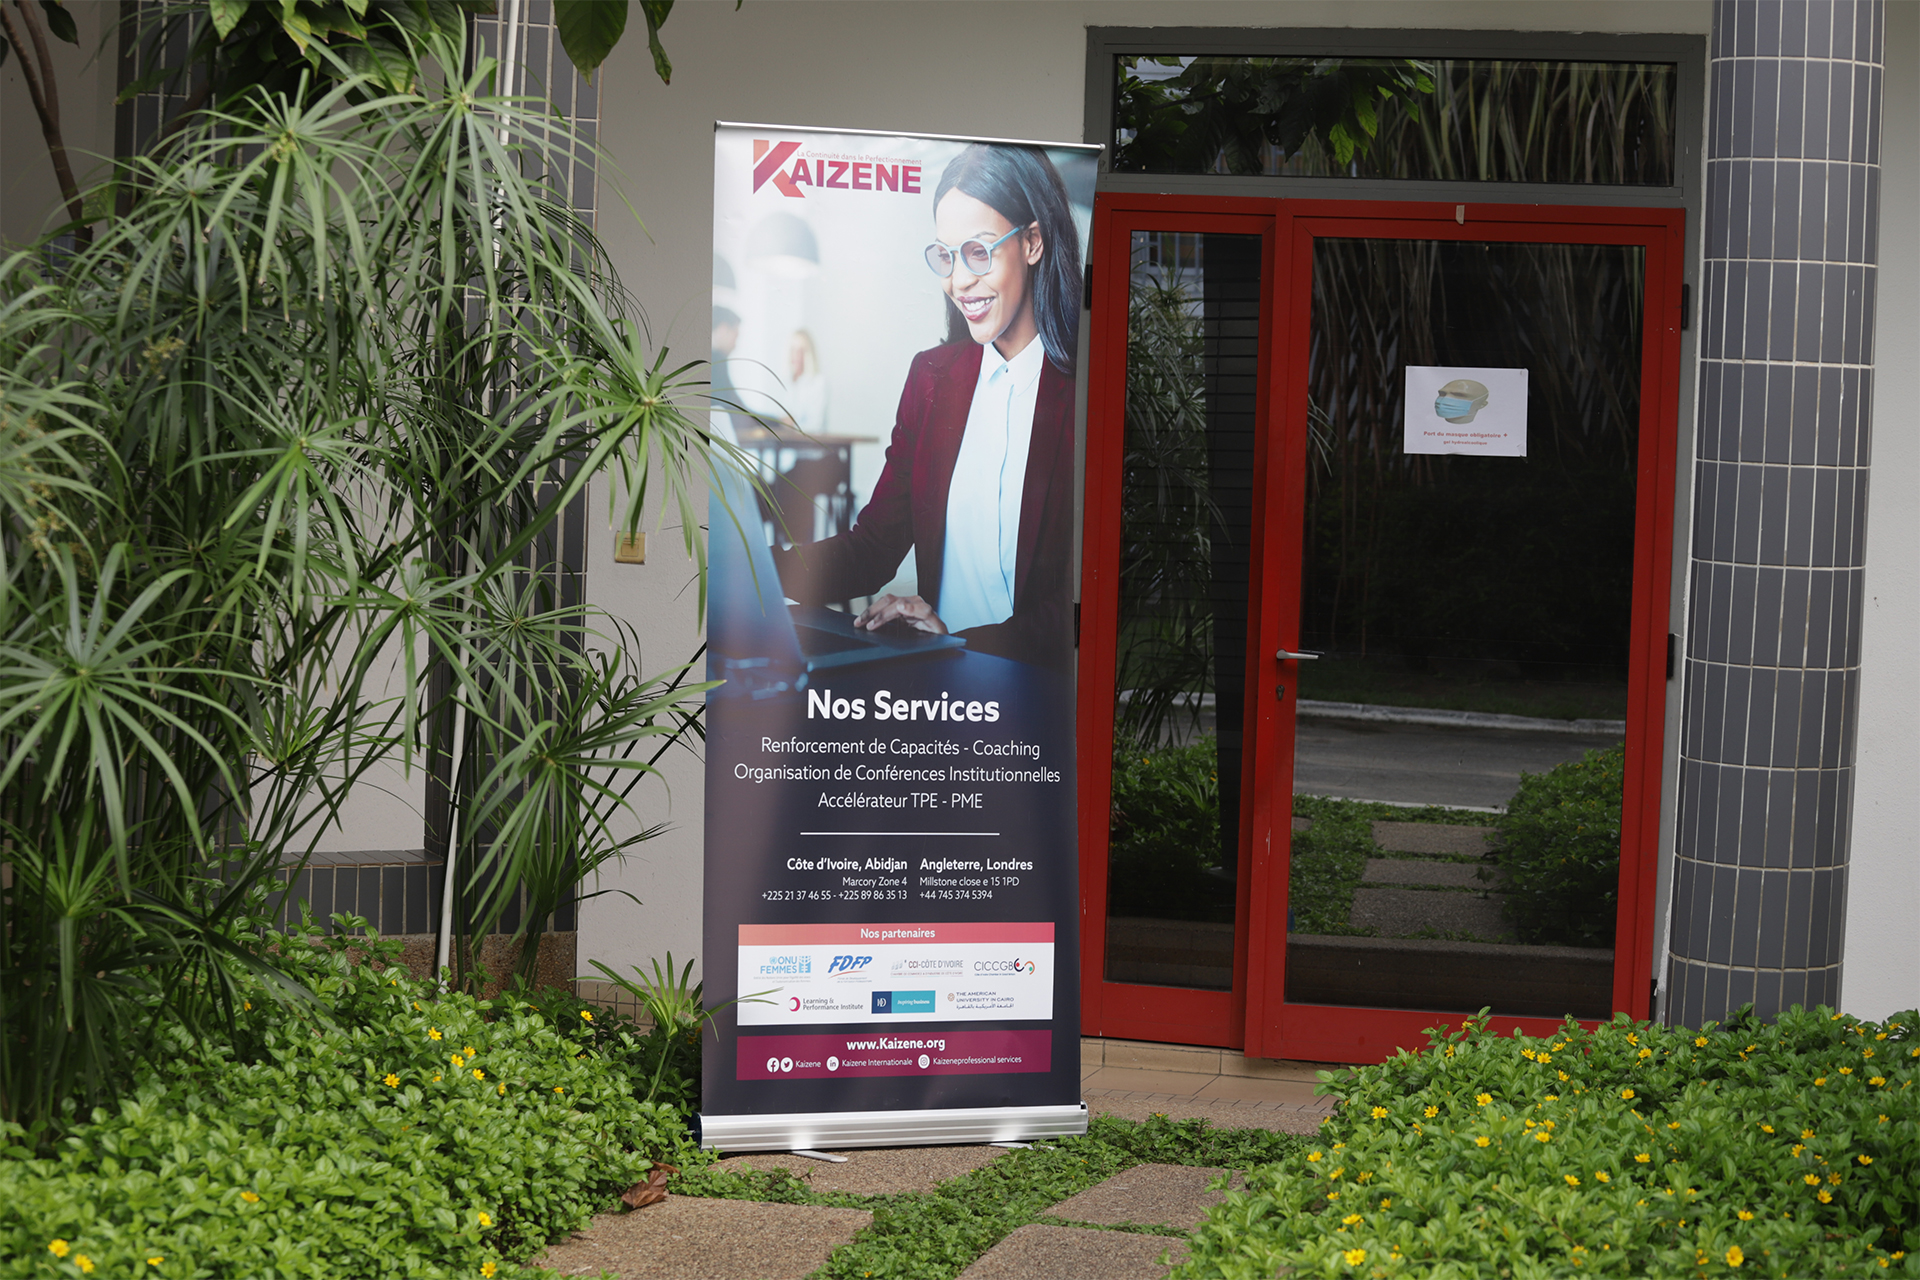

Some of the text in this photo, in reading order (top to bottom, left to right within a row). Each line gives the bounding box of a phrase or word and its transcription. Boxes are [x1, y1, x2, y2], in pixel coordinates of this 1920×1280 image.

[806, 150, 840, 160] Continuité
[865, 154, 922, 165] Perfectionnement
[807, 689, 1000, 722] Nos Services
[762, 737, 865, 754] Renforcement
[869, 738, 886, 754] de
[890, 738, 960, 758] Capacités
[973, 740, 1040, 760] Coaching
[734, 763, 1060, 783] Organisation de Conférences Institutionnelles
[818, 792, 907, 808] Accélérateur
[911, 793, 938, 808] TPE
[952, 793, 983, 808] PME
[787, 858, 814, 870] Côte
[865, 858, 908, 872] Abidjan
[920, 858, 1033, 872] Angleterre, Londres
[842, 877, 908, 888] Marcory Zone 4
[920, 876, 957, 886] Millstone
[959, 876, 980, 886] close
[990, 877, 1000, 886] 15
[1002, 877, 1020, 886] 1PD
[762, 890, 783, 900] +225
[785, 890, 794, 900] 21
[796, 890, 806, 900] 37
[808, 890, 819, 900] 46
[821, 890, 831, 900] 55
[838, 890, 859, 900] +225
[861, 890, 872, 900] 89
[874, 890, 885, 900] 86
[886, 890, 897, 900] 35
[899, 890, 907, 900] 13
[920, 890, 992, 900] +44 745 374 5394
[861, 928, 936, 940] Nos partenaires
[778, 956, 797, 964] ONU
[828, 955, 872, 973] FDFP
[908, 959, 936, 969] CCI-CÔTE
[760, 966, 797, 974] FEMMES
[846, 1038, 946, 1051] www.Kaizene.org
[796, 1060, 822, 1068] Kaizene
[842, 1057, 912, 1068] Kaizene Internationale
[933, 1055, 1022, 1066] Kaizeneprofessional services
